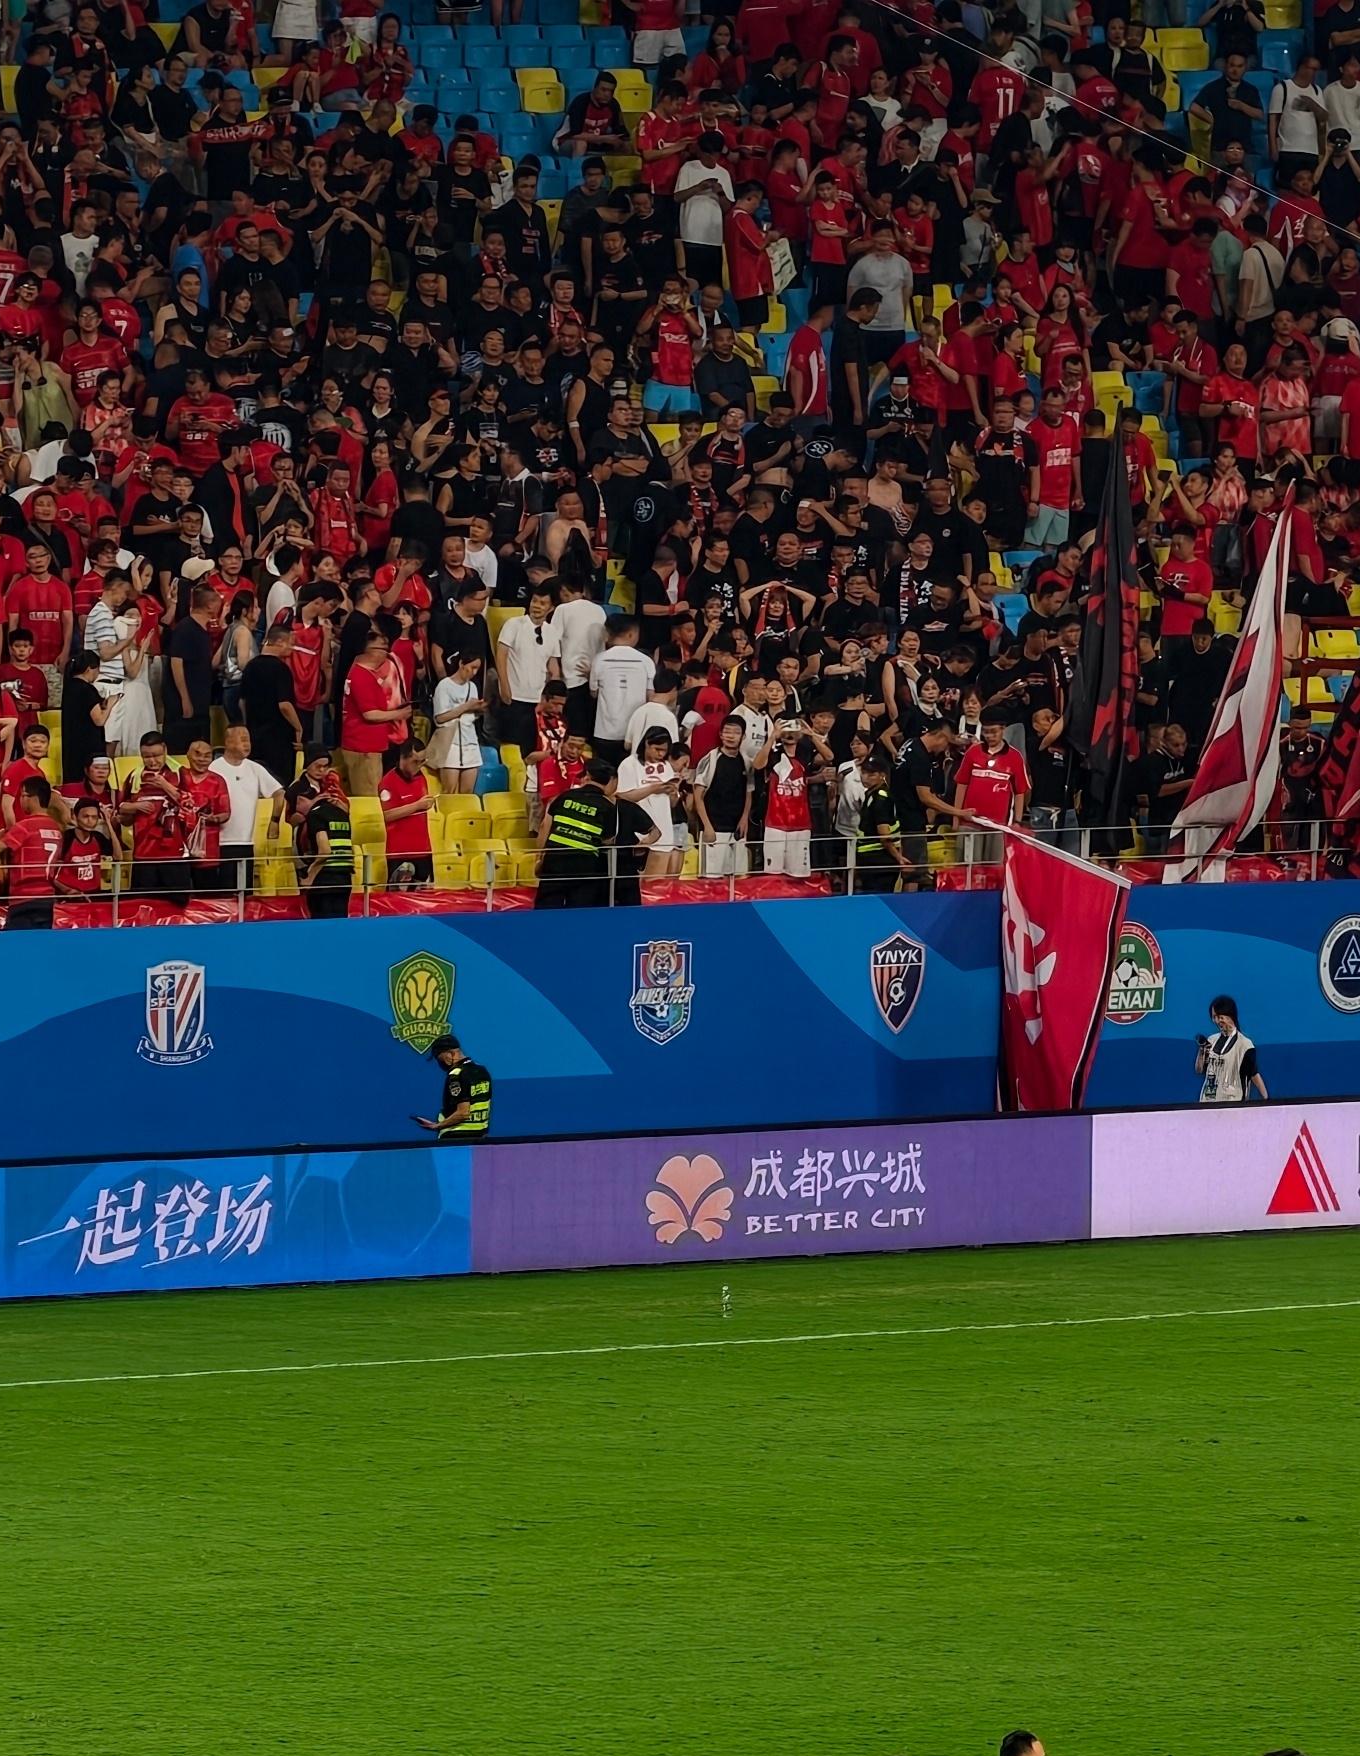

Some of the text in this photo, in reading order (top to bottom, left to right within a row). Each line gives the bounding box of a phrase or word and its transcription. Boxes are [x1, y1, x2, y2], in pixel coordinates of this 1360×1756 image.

[0, 272, 14, 303] 7
[876, 949, 919, 964] YNYK
[150, 997, 175, 1008] SFC
[1107, 990, 1156, 1010] ENAN
[402, 1022, 441, 1036] GUOAN
[743, 1143, 926, 1206] 成都兴城
[18, 1174, 273, 1275] 一起登场
[744, 1207, 926, 1235] BETTER CITY
